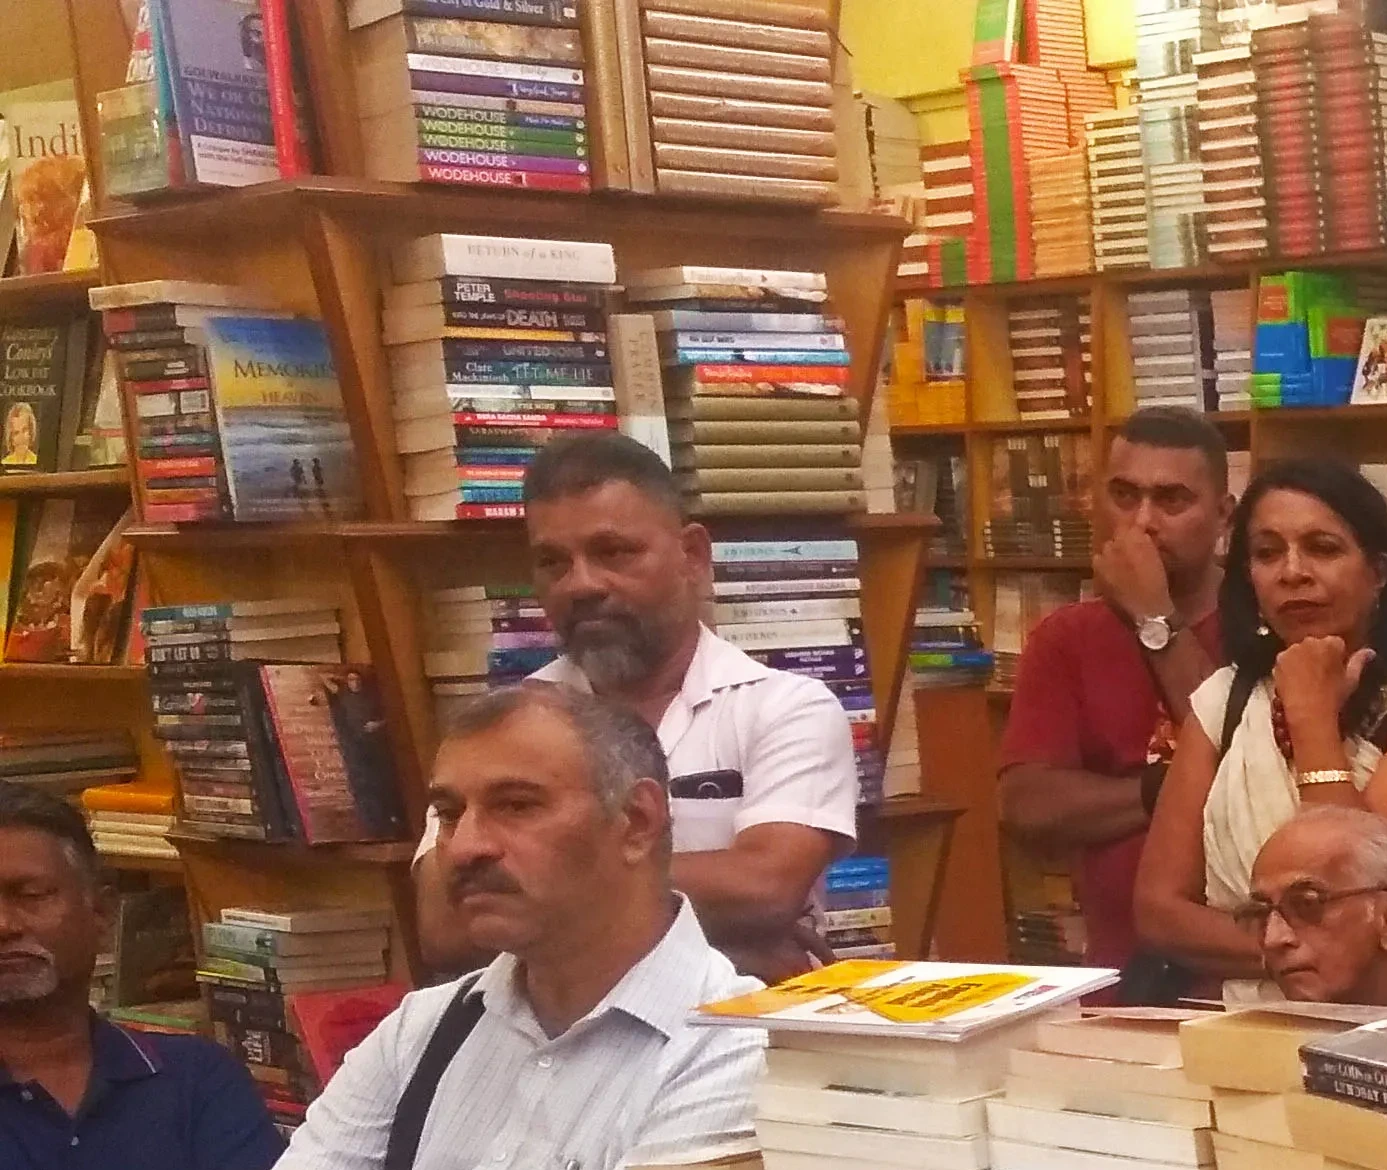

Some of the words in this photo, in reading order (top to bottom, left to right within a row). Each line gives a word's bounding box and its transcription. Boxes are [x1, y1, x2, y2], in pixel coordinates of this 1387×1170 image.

[515, 3, 544, 15] Silver
[422, 106, 507, 124] WODEHOUSE
[422, 119, 507, 138] WODEHOUSE
[13, 123, 82, 158] Indi
[422, 134, 507, 152] WODEHOUSE
[424, 150, 510, 168] WODEHOUSE
[427, 167, 512, 185] WODEHOUSE
[456, 282, 491, 293] PETER
[454, 291, 497, 303] TEMPLE
[506, 308, 558, 327] DEATH
[466, 361, 493, 373] Clare
